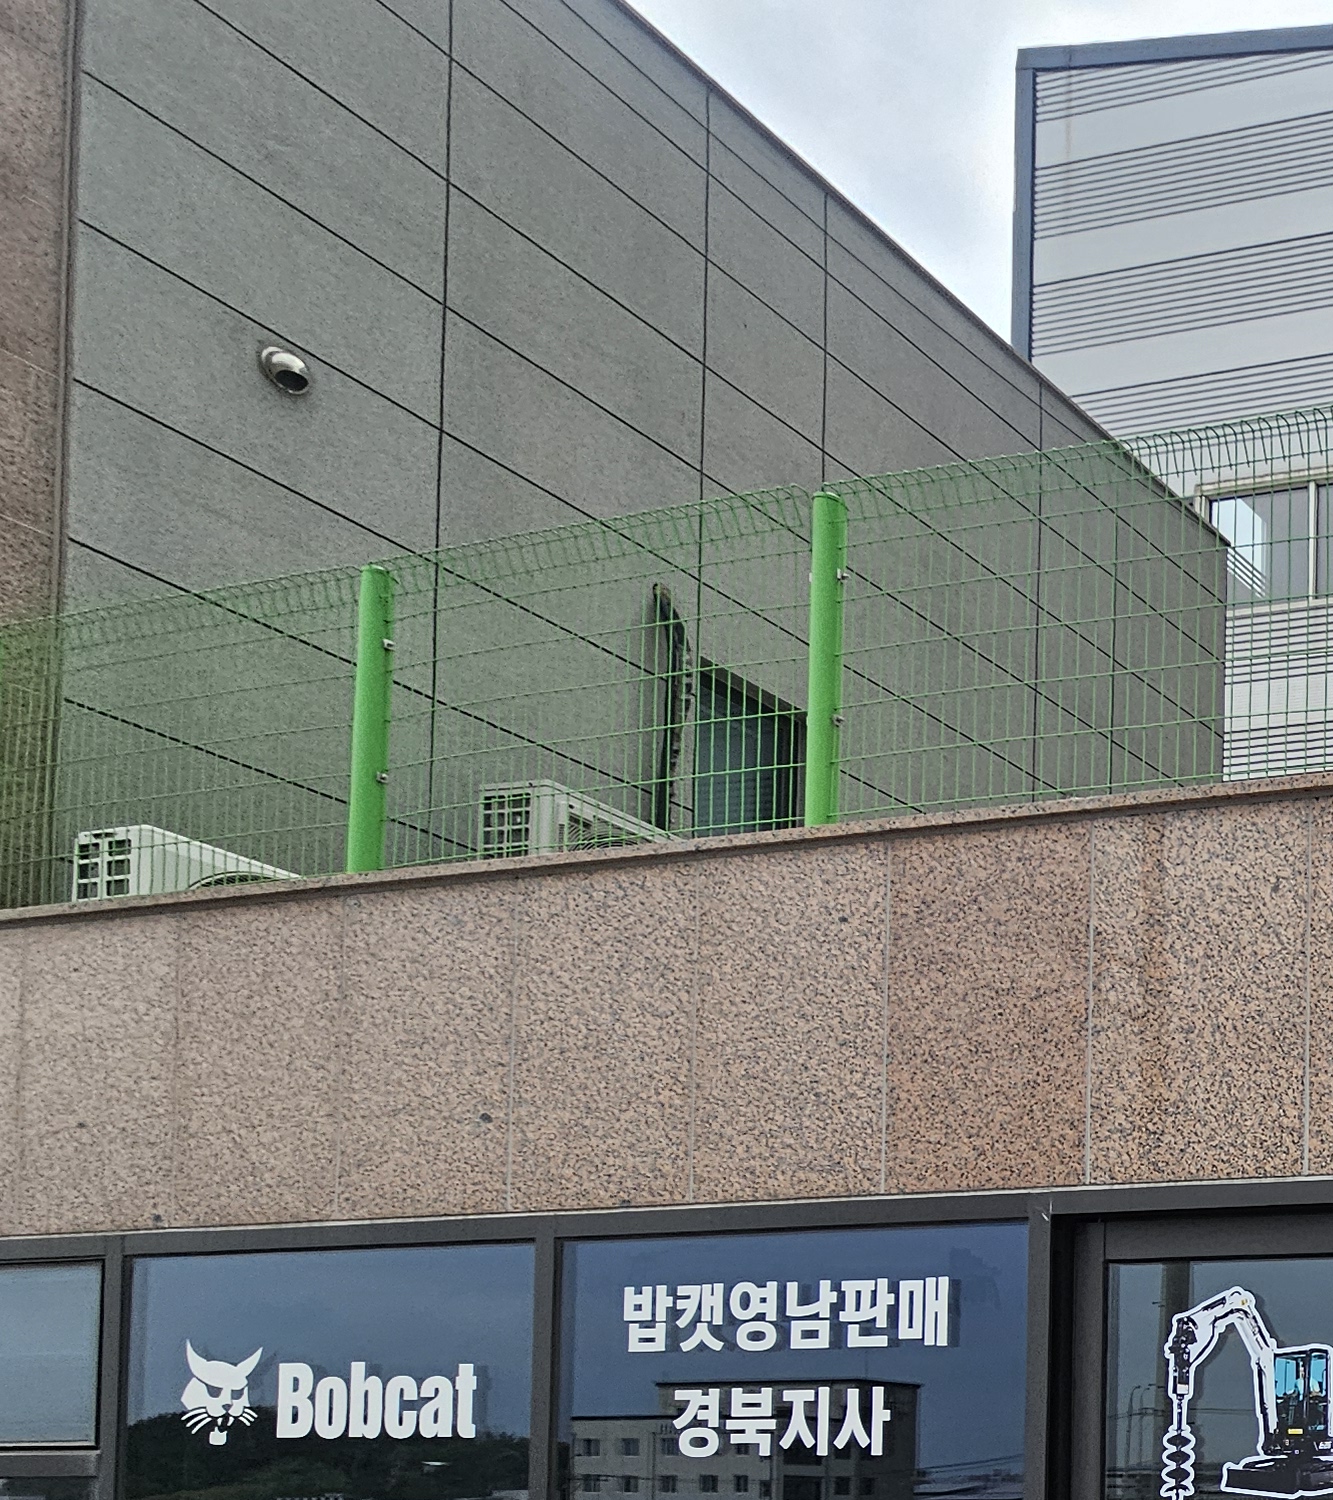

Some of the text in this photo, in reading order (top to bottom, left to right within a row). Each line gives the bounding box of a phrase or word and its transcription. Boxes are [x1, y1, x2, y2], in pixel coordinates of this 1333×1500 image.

[622, 1275, 950, 1353] 밥캣영남판매
[275, 1361, 478, 1440] Bobcat
[671, 1385, 892, 1459] 경북지사
